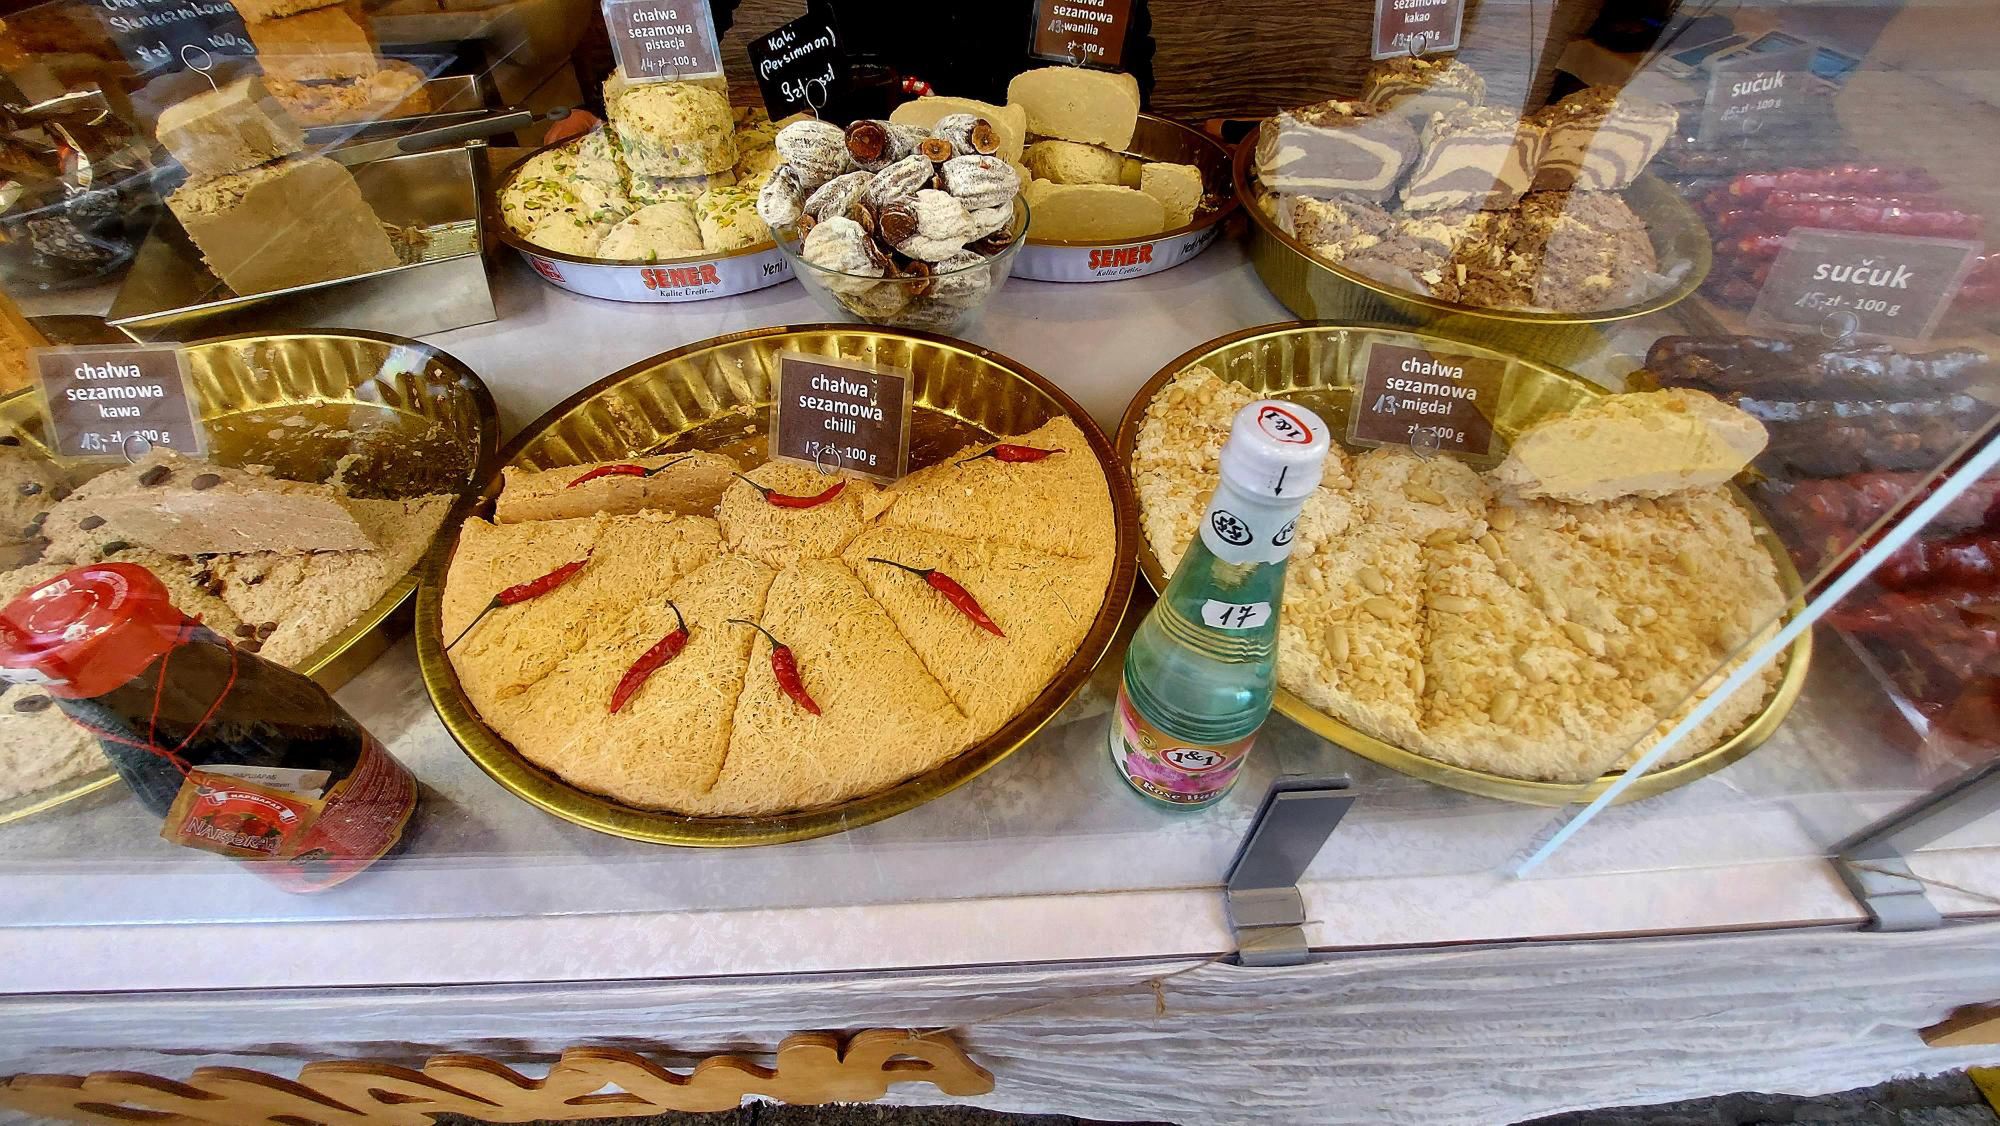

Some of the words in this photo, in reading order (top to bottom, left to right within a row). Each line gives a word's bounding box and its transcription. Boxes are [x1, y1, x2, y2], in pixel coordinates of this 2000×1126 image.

[633, 8, 677, 22] chałwa
[1053, 5, 1114, 24] sezamowa
[1405, 12, 1430, 23] kakao
[628, 24, 693, 39] sezamowa
[768, 24, 796, 51] Kaki
[1064, 22, 1099, 36] wanilia
[645, 37, 685, 52] pistacja
[761, 26, 836, 80] (Persimmon)
[1083, 43, 1098, 53] 100
[1098, 46, 1104, 56] g
[673, 56, 689, 66] 100
[691, 58, 698, 67] g
[1731, 70, 1785, 97] sučuk
[763, 261, 783, 277] Yeni
[1813, 259, 1915, 289] sučuk
[660, 289, 683, 298] Kalite
[1854, 299, 1888, 312] 100
[1888, 305, 1902, 317] g
[74, 361, 141, 380] chałwa
[1401, 357, 1463, 379] chałwa
[66, 384, 164, 401] sezamowa
[811, 374, 868, 398] chałwa
[1385, 377, 1477, 401] sezamowa
[98, 404, 141, 418] kawa
[799, 395, 883, 421] sezamowa
[1402, 397, 1453, 416] migdał
[824, 417, 856, 435] chilli
[1430, 426, 1454, 439] 100
[1455, 430, 1465, 443] g
[110, 430, 122, 443] zł
[162, 432, 170, 443] g
[846, 447, 867, 462] 100
[869, 454, 877, 466] g
[1220, 606, 1256, 628] 17
[1173, 751, 1214, 766] 1&1
[1143, 781, 1181, 800] Rose
